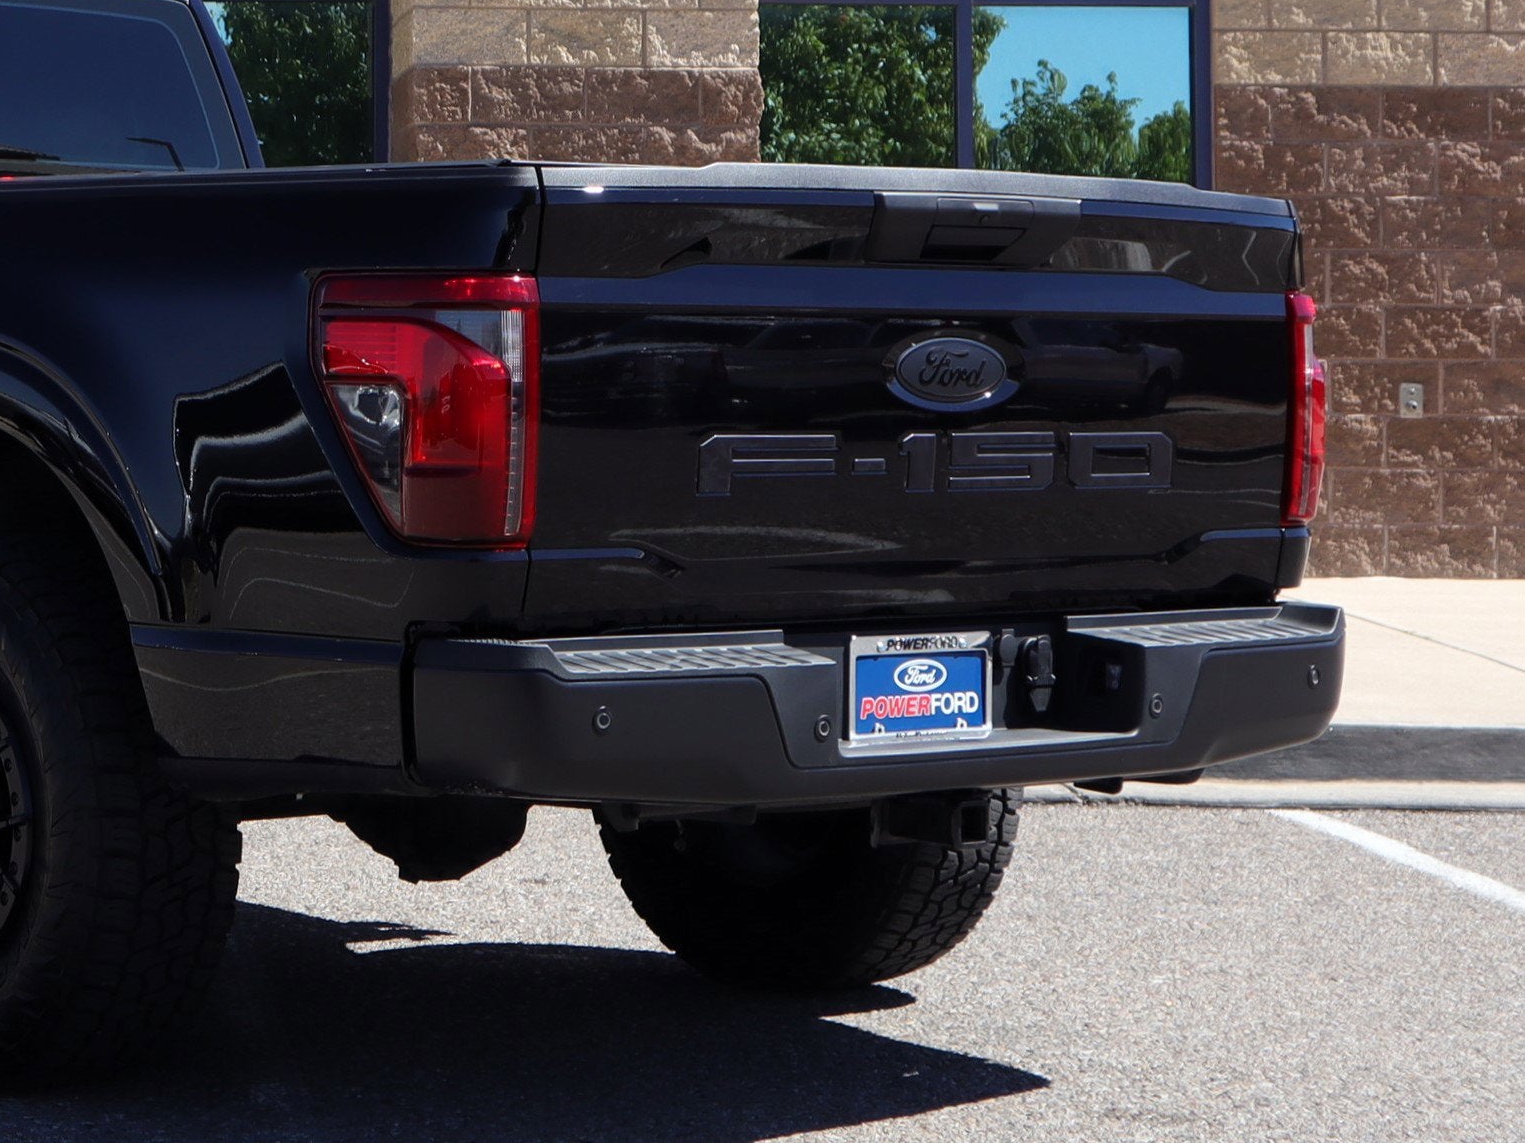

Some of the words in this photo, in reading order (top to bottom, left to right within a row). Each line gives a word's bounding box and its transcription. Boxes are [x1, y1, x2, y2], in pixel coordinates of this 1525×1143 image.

[918, 346, 990, 389] Ford
[695, 431, 1173, 496] F-150
[904, 665, 937, 685] Ford
[860, 691, 979, 720] POWERFORD
